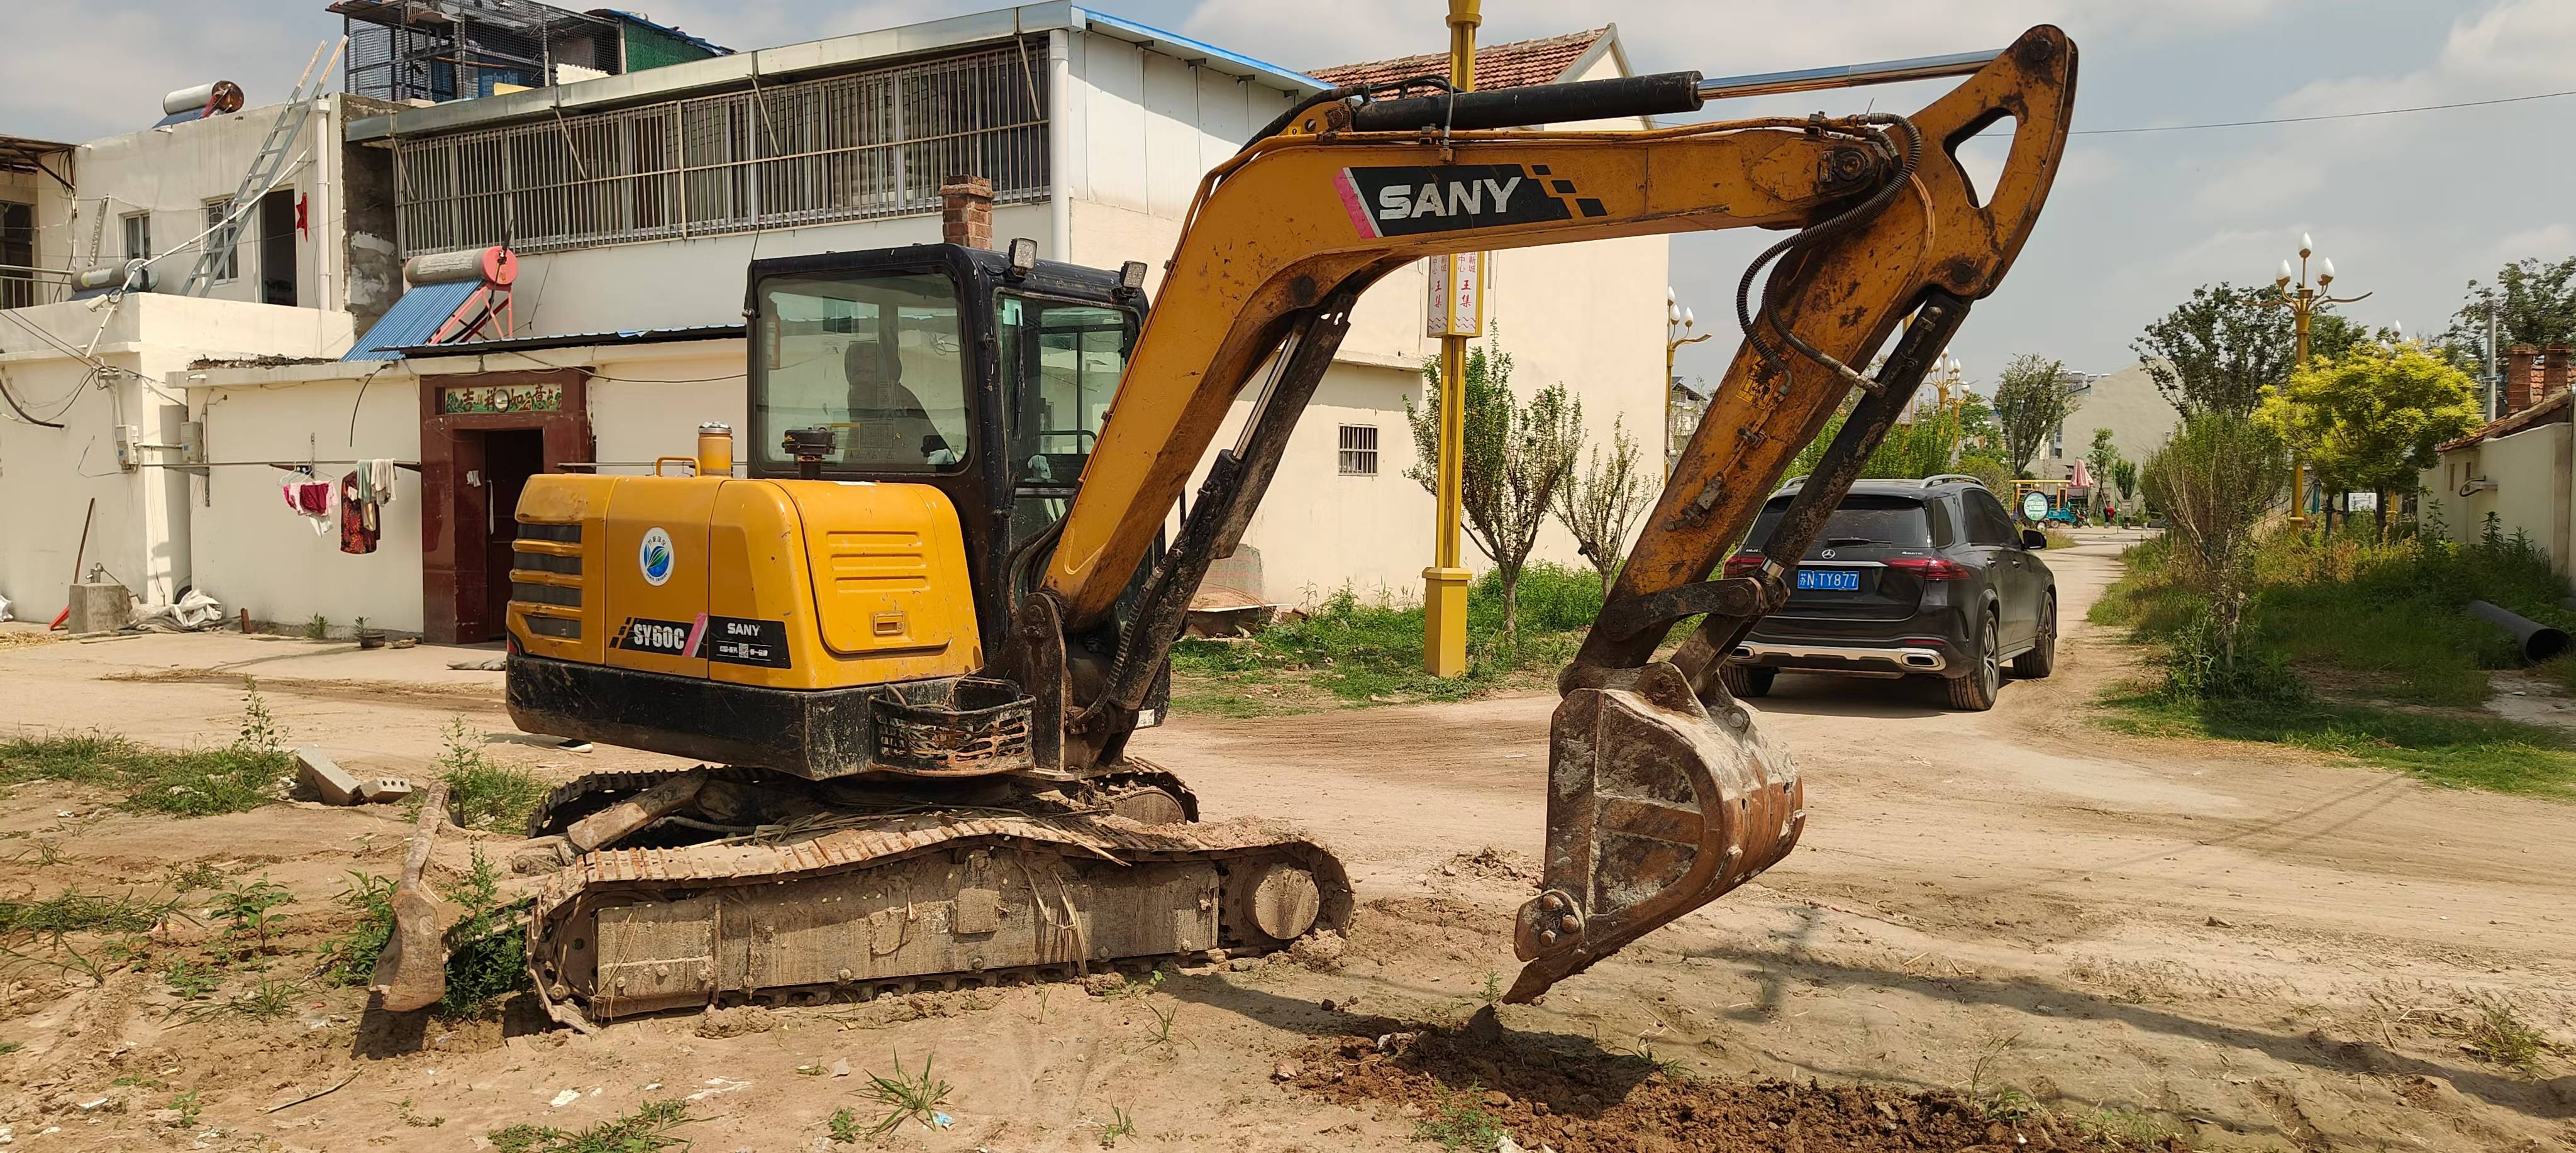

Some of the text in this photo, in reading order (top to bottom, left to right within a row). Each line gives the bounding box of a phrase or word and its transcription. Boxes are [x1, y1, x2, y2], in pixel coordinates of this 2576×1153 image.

[1379, 177, 1522, 220] SANY
[1460, 279, 1472, 308] 王集
[633, 623, 684, 649] SY60C
[727, 622, 761, 637] SANY
